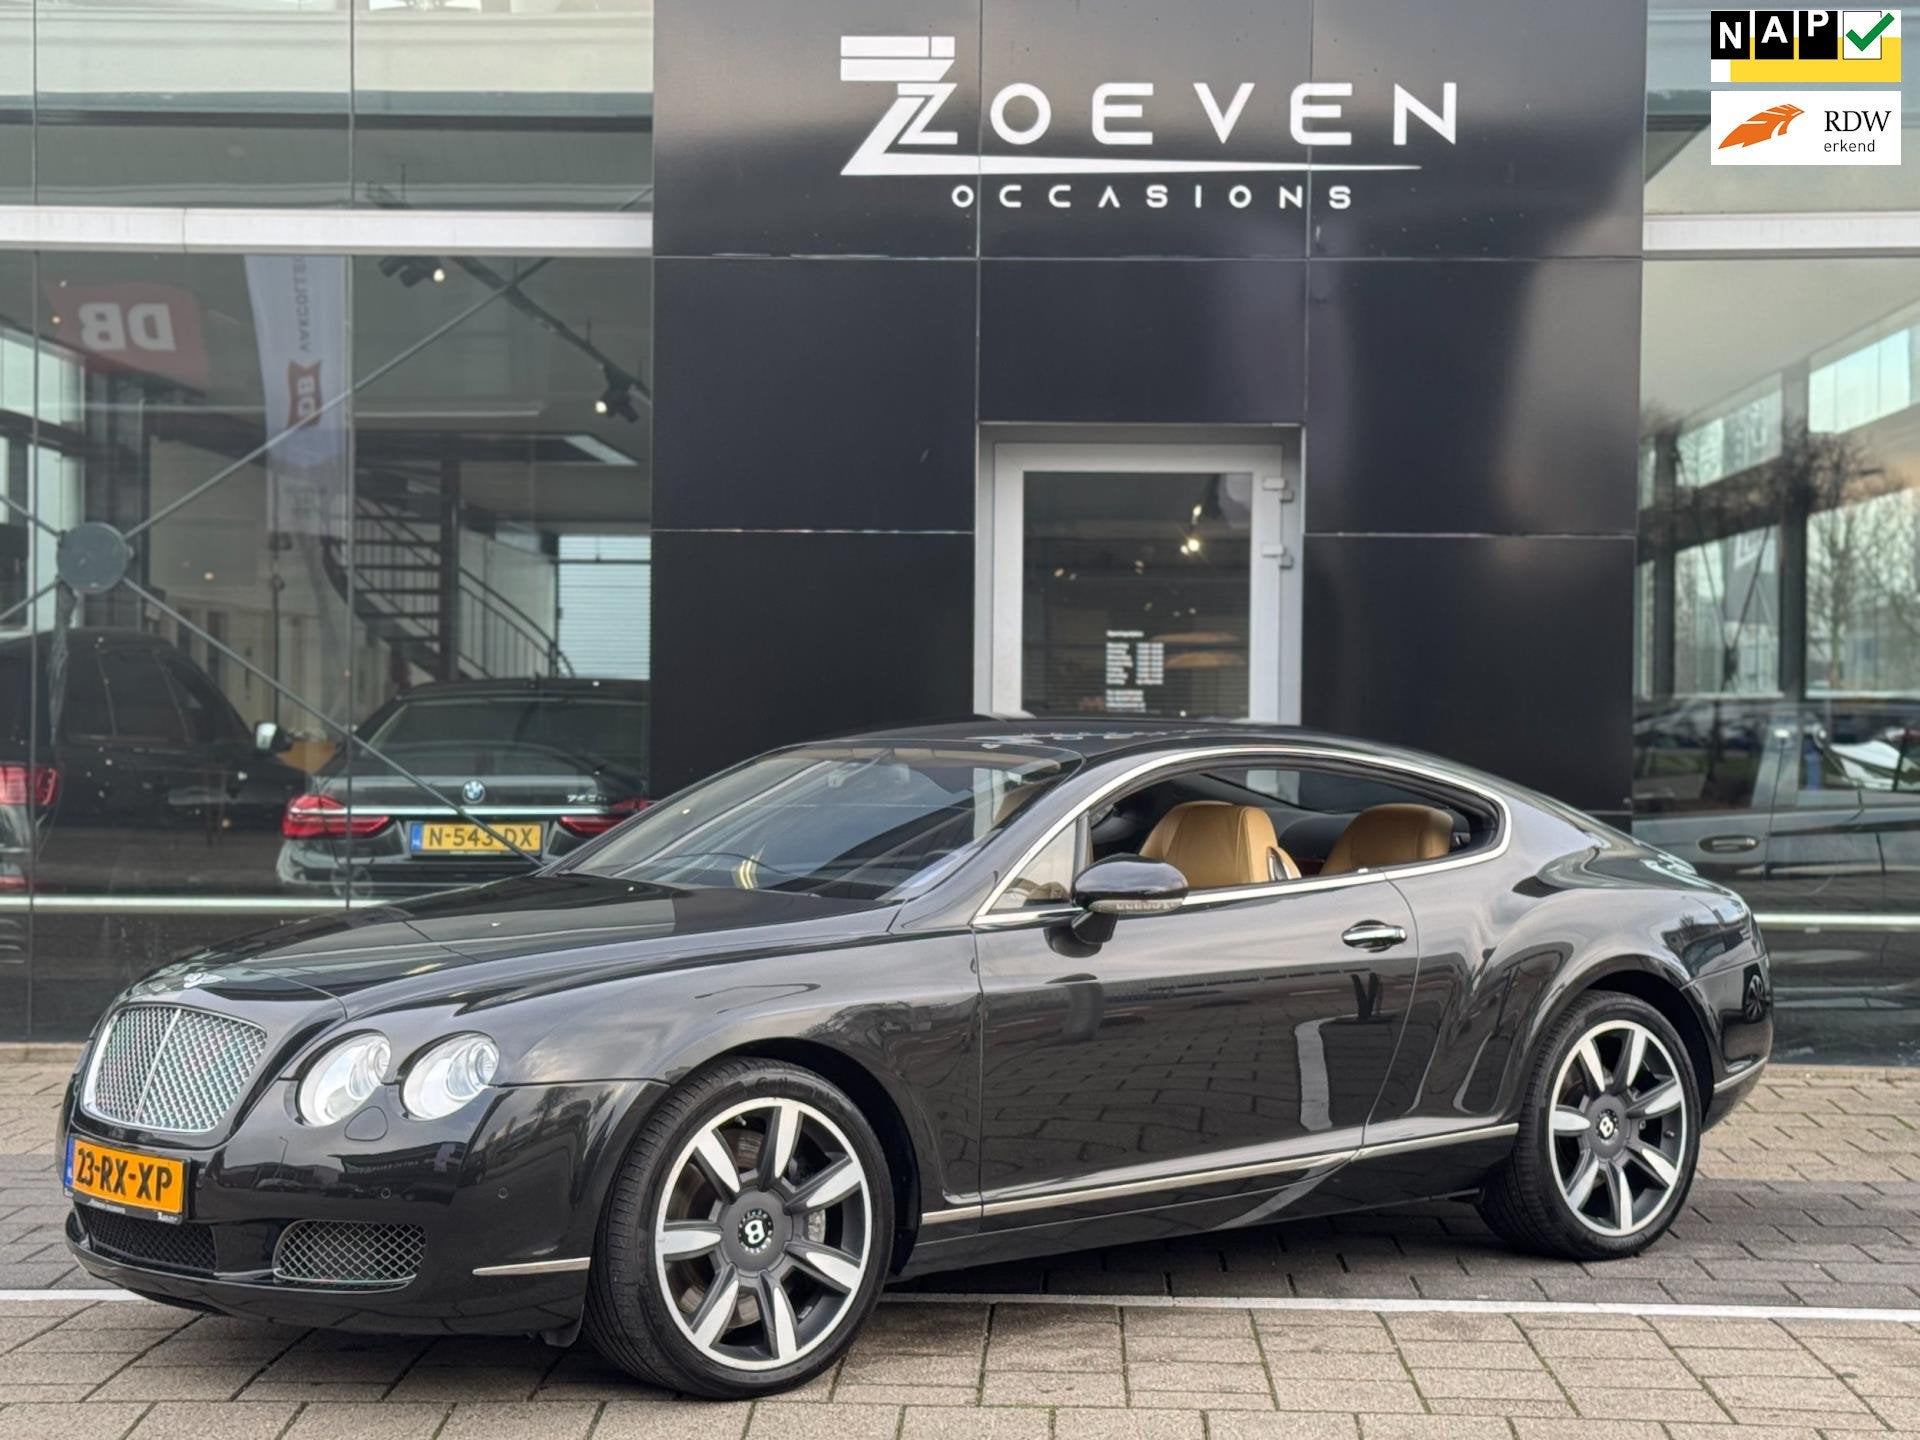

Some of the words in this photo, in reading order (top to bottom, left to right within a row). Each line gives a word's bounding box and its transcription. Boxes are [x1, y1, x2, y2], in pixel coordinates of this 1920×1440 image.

[841, 36, 1457, 175] ZOEVEN
[952, 185, 1351, 209] OCCASIONS
[429, 827, 533, 848] N-543DX
[76, 1147, 173, 1202] 23-RX-XP
